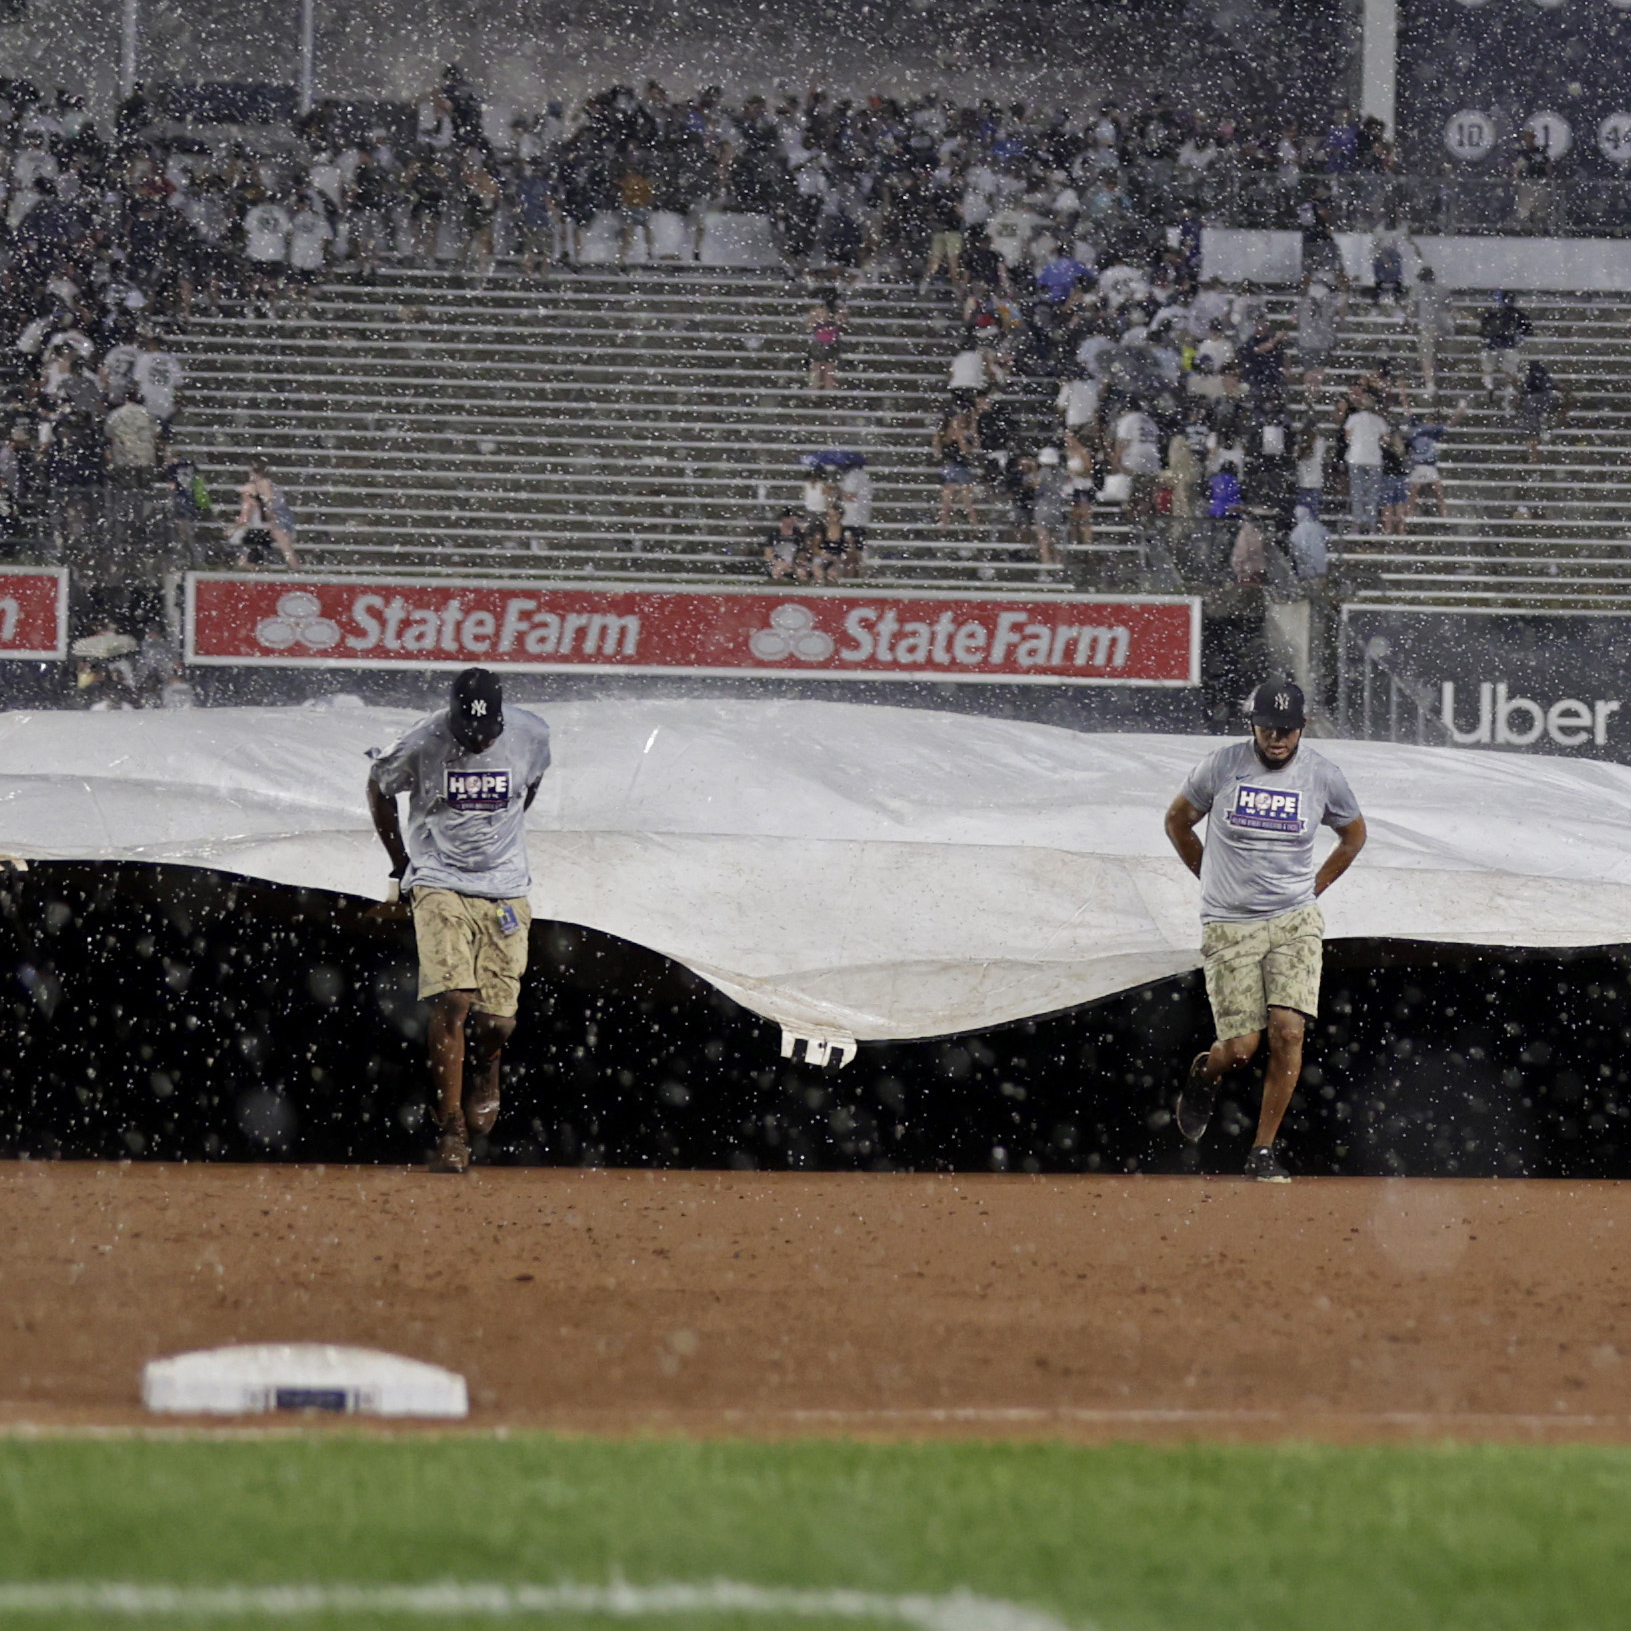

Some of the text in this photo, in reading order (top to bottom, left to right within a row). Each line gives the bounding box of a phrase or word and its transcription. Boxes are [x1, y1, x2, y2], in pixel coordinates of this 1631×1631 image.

[1456, 123, 1483, 148] 10
[471, 699, 487, 717] NY
[1274, 692, 1290, 710] NY
[1440, 680, 1615, 748] Uber
[450, 774, 508, 794] HOPE
[1239, 790, 1297, 814] HOPE
[1245, 809, 1288, 819] WEEK
